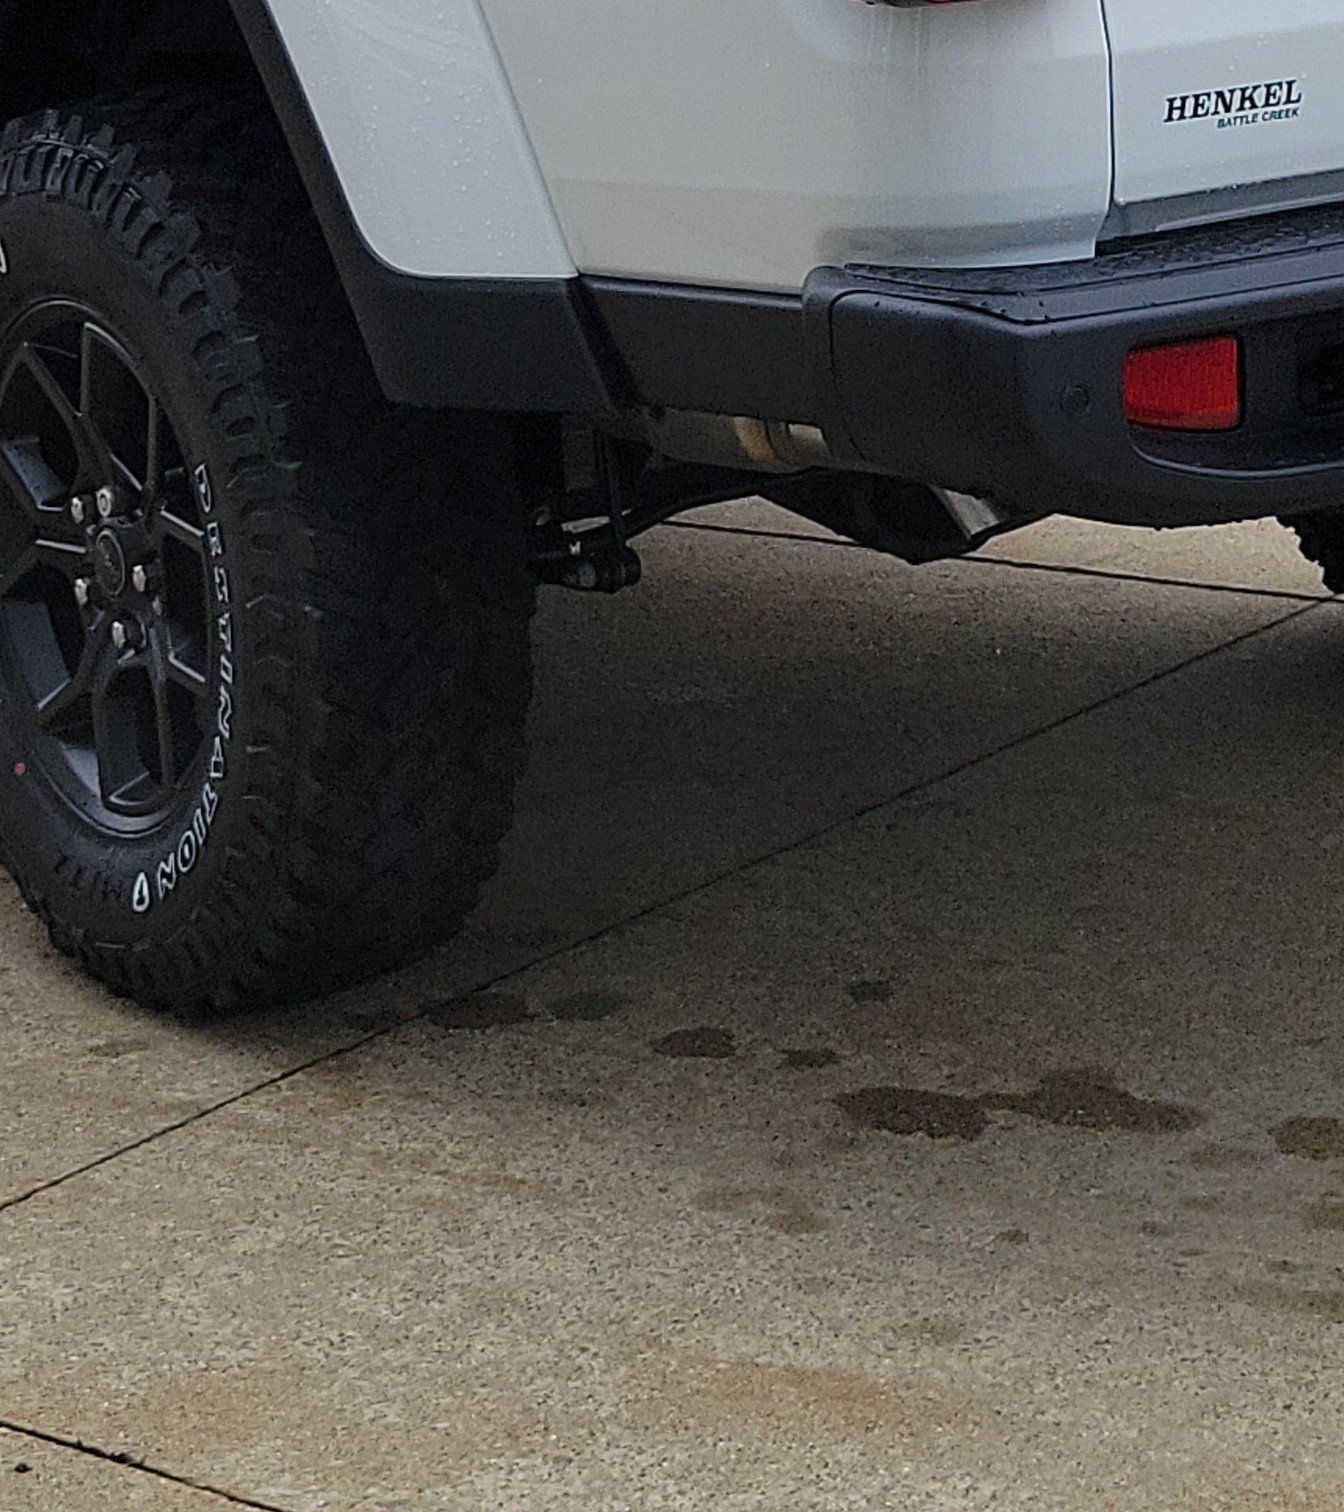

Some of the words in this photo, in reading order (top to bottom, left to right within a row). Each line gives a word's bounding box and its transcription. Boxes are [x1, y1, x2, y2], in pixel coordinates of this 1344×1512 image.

[1163, 79, 1302, 122] HENKEL
[1217, 112, 1259, 129] BATTLE
[1261, 107, 1299, 122] CREEK
[159, 463, 235, 900] DESTINATION
